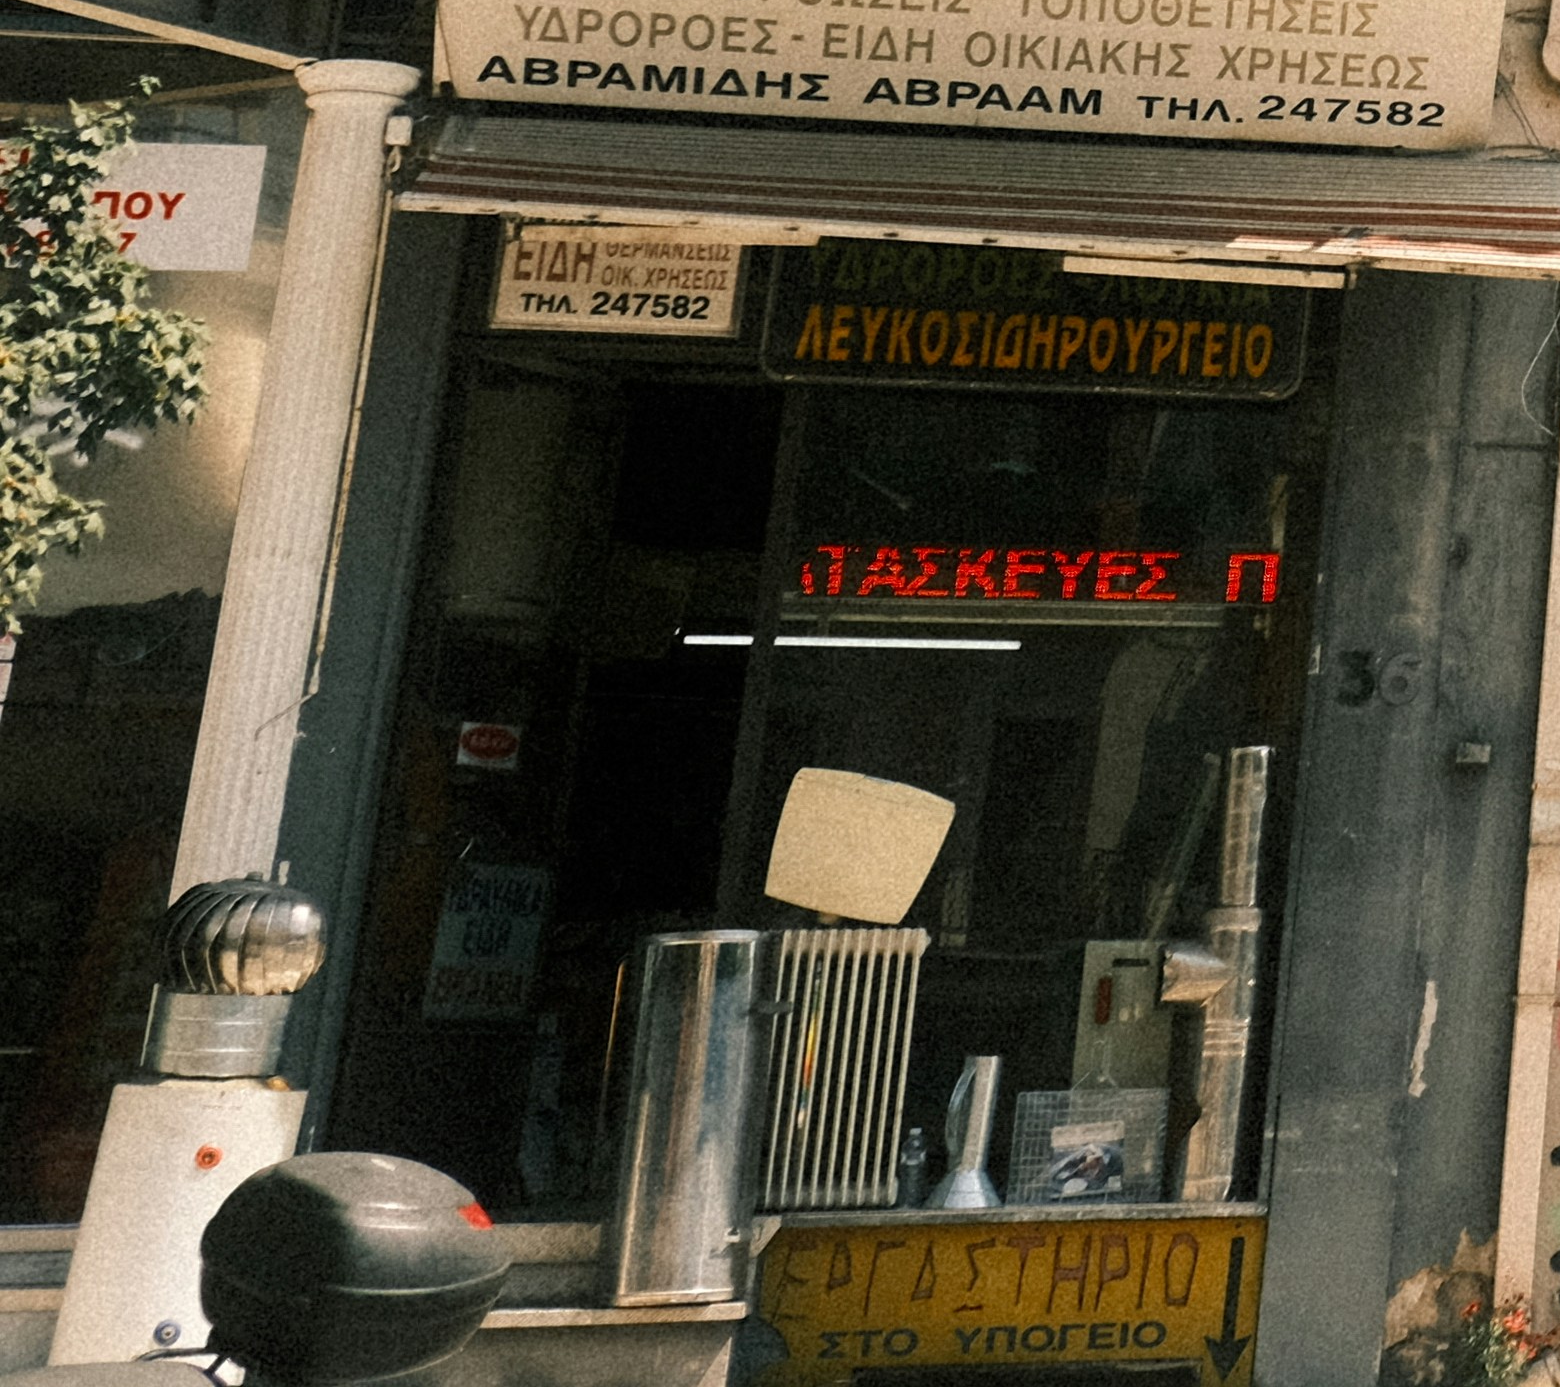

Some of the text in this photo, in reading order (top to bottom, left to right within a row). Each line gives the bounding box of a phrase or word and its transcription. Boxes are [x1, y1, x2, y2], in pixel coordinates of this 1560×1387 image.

[514, 4, 778, 55] ΥΔΡΟΡΟΕΣ
[822, 23, 936, 64] ΕΙΔΗ
[964, 30, 1192, 78] ΟΙΚΙΑΚΗΣ
[1217, 45, 1430, 91] ΧΡΗΣΕΩΣ
[477, 55, 1446, 127] ΑΒΡΑΜΙΔΗΣ ΑΒΡΑΑΜ ΤΗΛ. 247582
[513, 241, 597, 284] ΕΙΔΗ
[602, 265, 728, 291] ΟΙΚ. ΧΡΗΣΕΩΣ
[520, 292, 710, 319] ΤΗΛ. 247582
[795, 304, 1273, 378] ΛΕΥΚΟΣΙΔΗΡΟΥΡΓΕΙΟ
[801, 545, 1181, 601] ΤΑΣΚΕΥΕΣ
[772, 1233, 1199, 1320] ΕΡΓΑΣΤΗΡΙΟ
[820, 1321, 1167, 1360] ΣΤΟ ΥΠΟΓΕΙΟ
